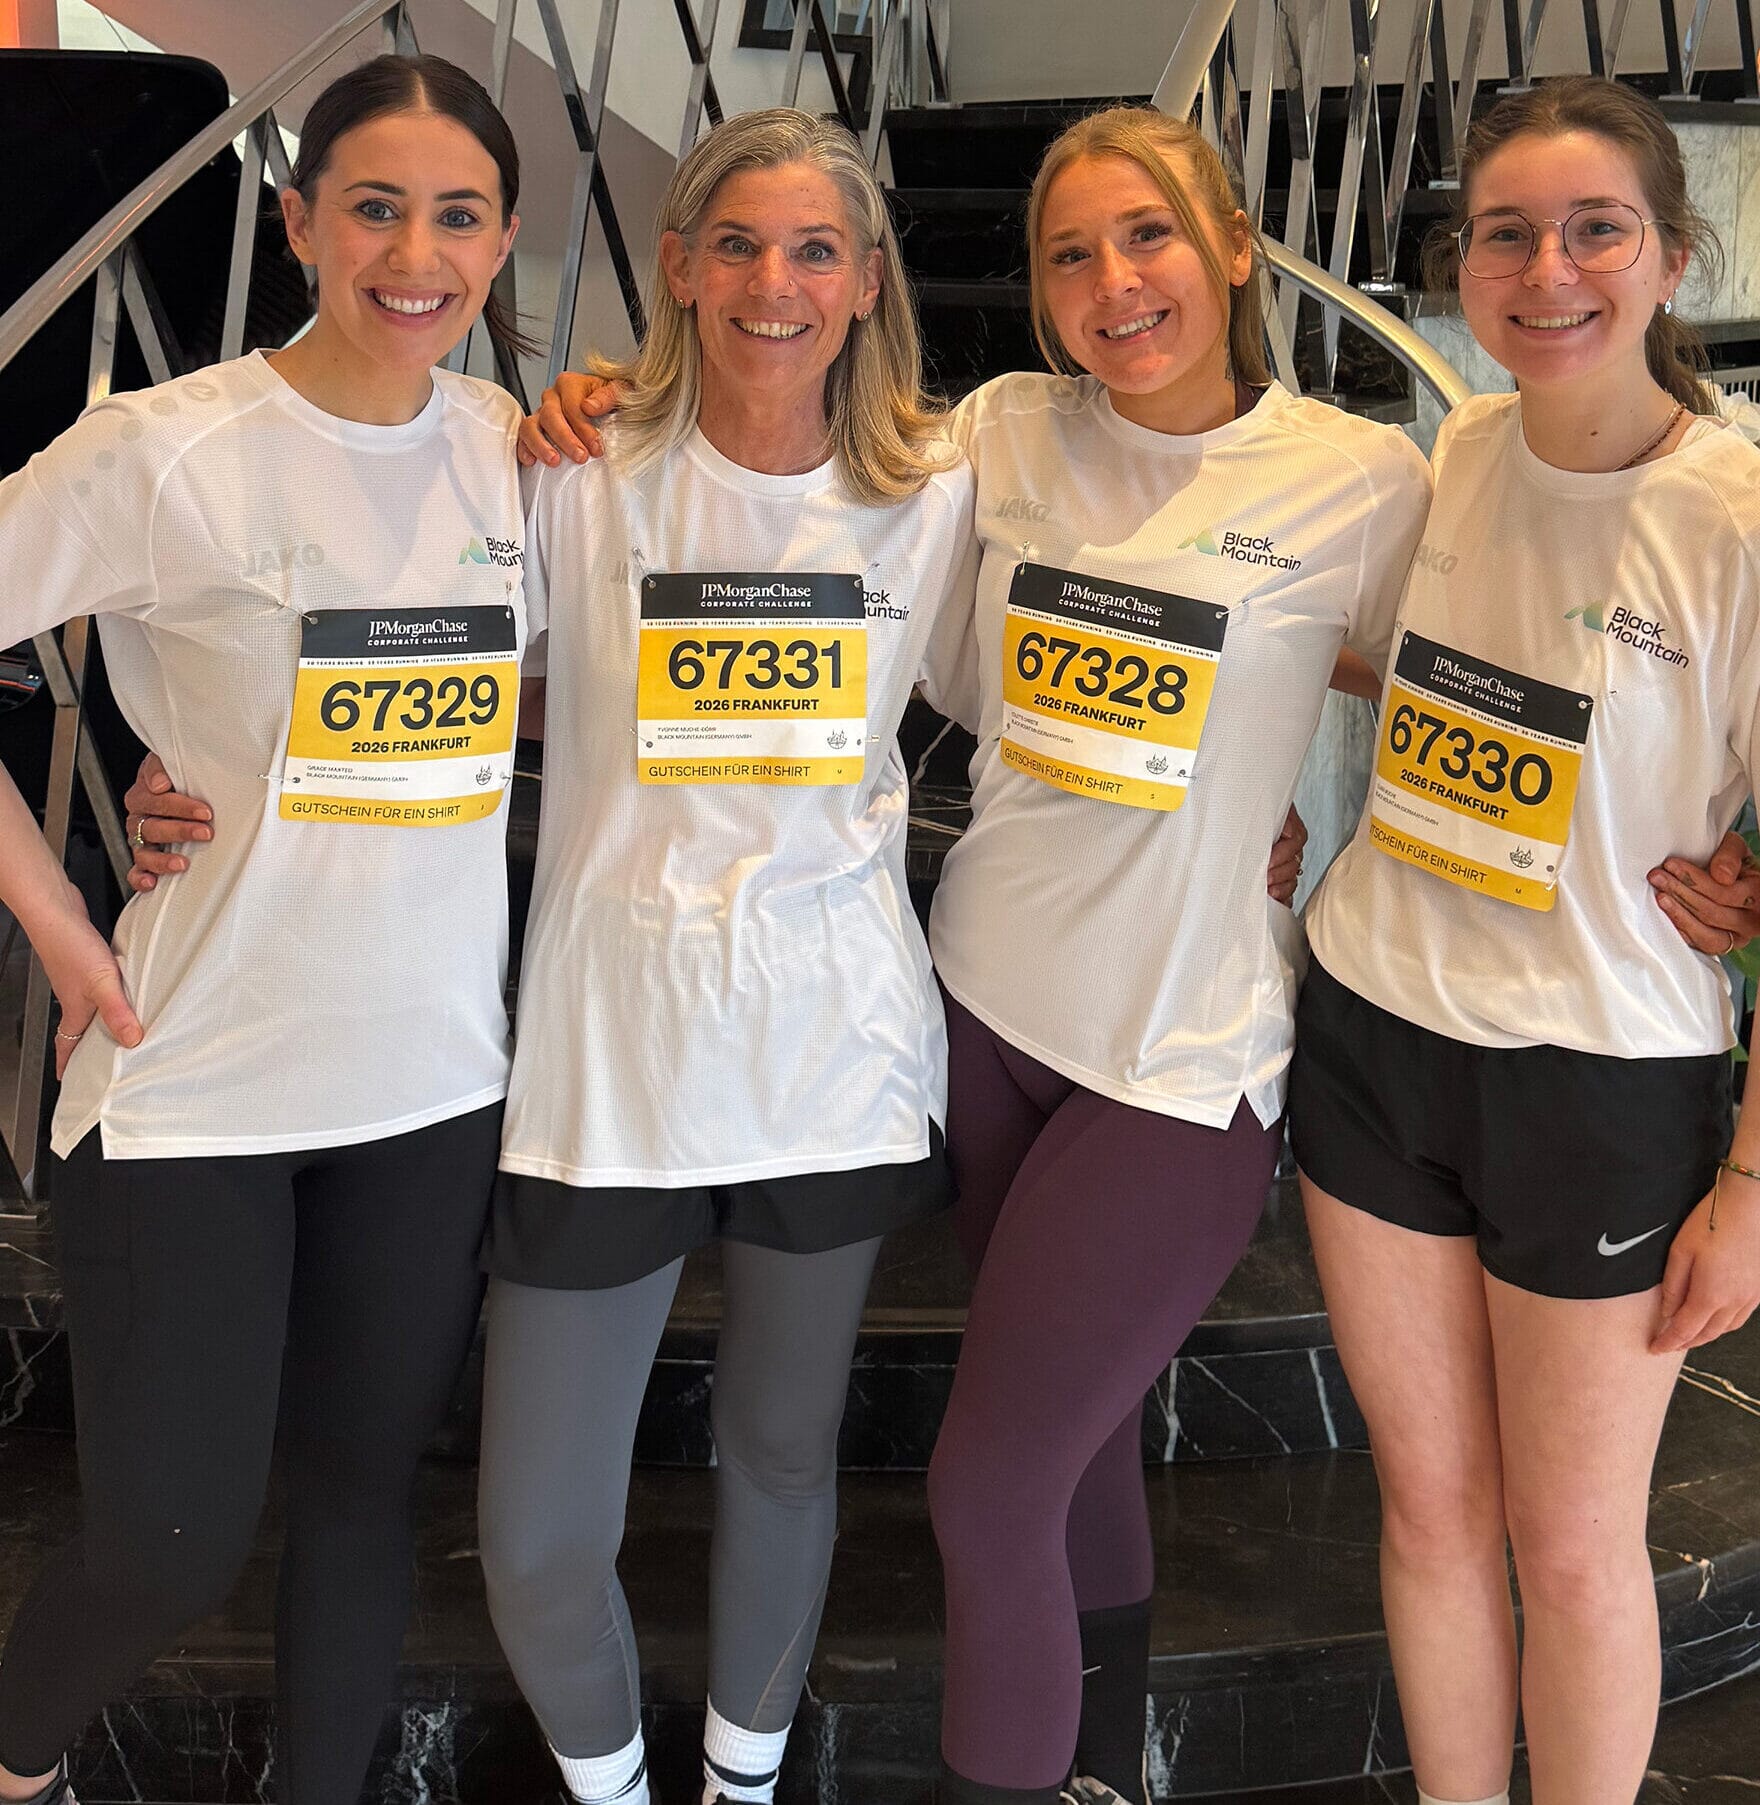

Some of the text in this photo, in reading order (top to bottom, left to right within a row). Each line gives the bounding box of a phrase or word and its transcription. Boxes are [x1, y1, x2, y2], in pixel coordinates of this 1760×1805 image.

[996, 498, 1049, 522] JAKO
[485, 537, 520, 553] Black
[1223, 531, 1275, 554] Black
[489, 550, 524, 567] Moun
[1220, 545, 1302, 571] Mountain
[1418, 543, 1459, 575] AKO
[700, 583, 811, 600] JPMorganChase
[700, 600, 812, 608] CORPORATE CHALLENGE
[863, 589, 890, 604] ack
[1060, 581, 1163, 617] JPMorganChase
[367, 618, 468, 638] JPMorganChase
[1058, 598, 1161, 628] CORPORATE CHALLENGE
[1611, 606, 1666, 641] Black
[367, 636, 469, 647] CORPORATE CHALLENGE
[1605, 620, 1690, 669] Mountain
[668, 640, 842, 690] 67331
[1016, 631, 1188, 715] 67328
[1432, 655, 1525, 702] JPMorganChase
[320, 674, 500, 732] 67329
[694, 699, 819, 711] 2026 FRANKFURT
[1429, 673, 1473, 695] CORPORATE
[1474, 687, 1522, 714] CHALLENGE
[1033, 693, 1062, 710] 2026
[1063, 701, 1147, 731] FRANKFURT
[351, 736, 472, 753] 2026 FRANKFURT
[1390, 704, 1553, 806] 67330
[649, 763, 811, 777] GUTSCHEIN FÜR EIN SHIRT
[1004, 747, 1124, 795] GUTSCHEIN FÜR EIN SHIRT
[1400, 768, 1427, 790] 2026
[1429, 781, 1509, 820] FRANKFURT
[291, 802, 461, 819] GUTSCHEIN FÜR EIN SHIRT
[1370, 824, 1488, 884] TSCHEIN FÜR EIN SHIRT
